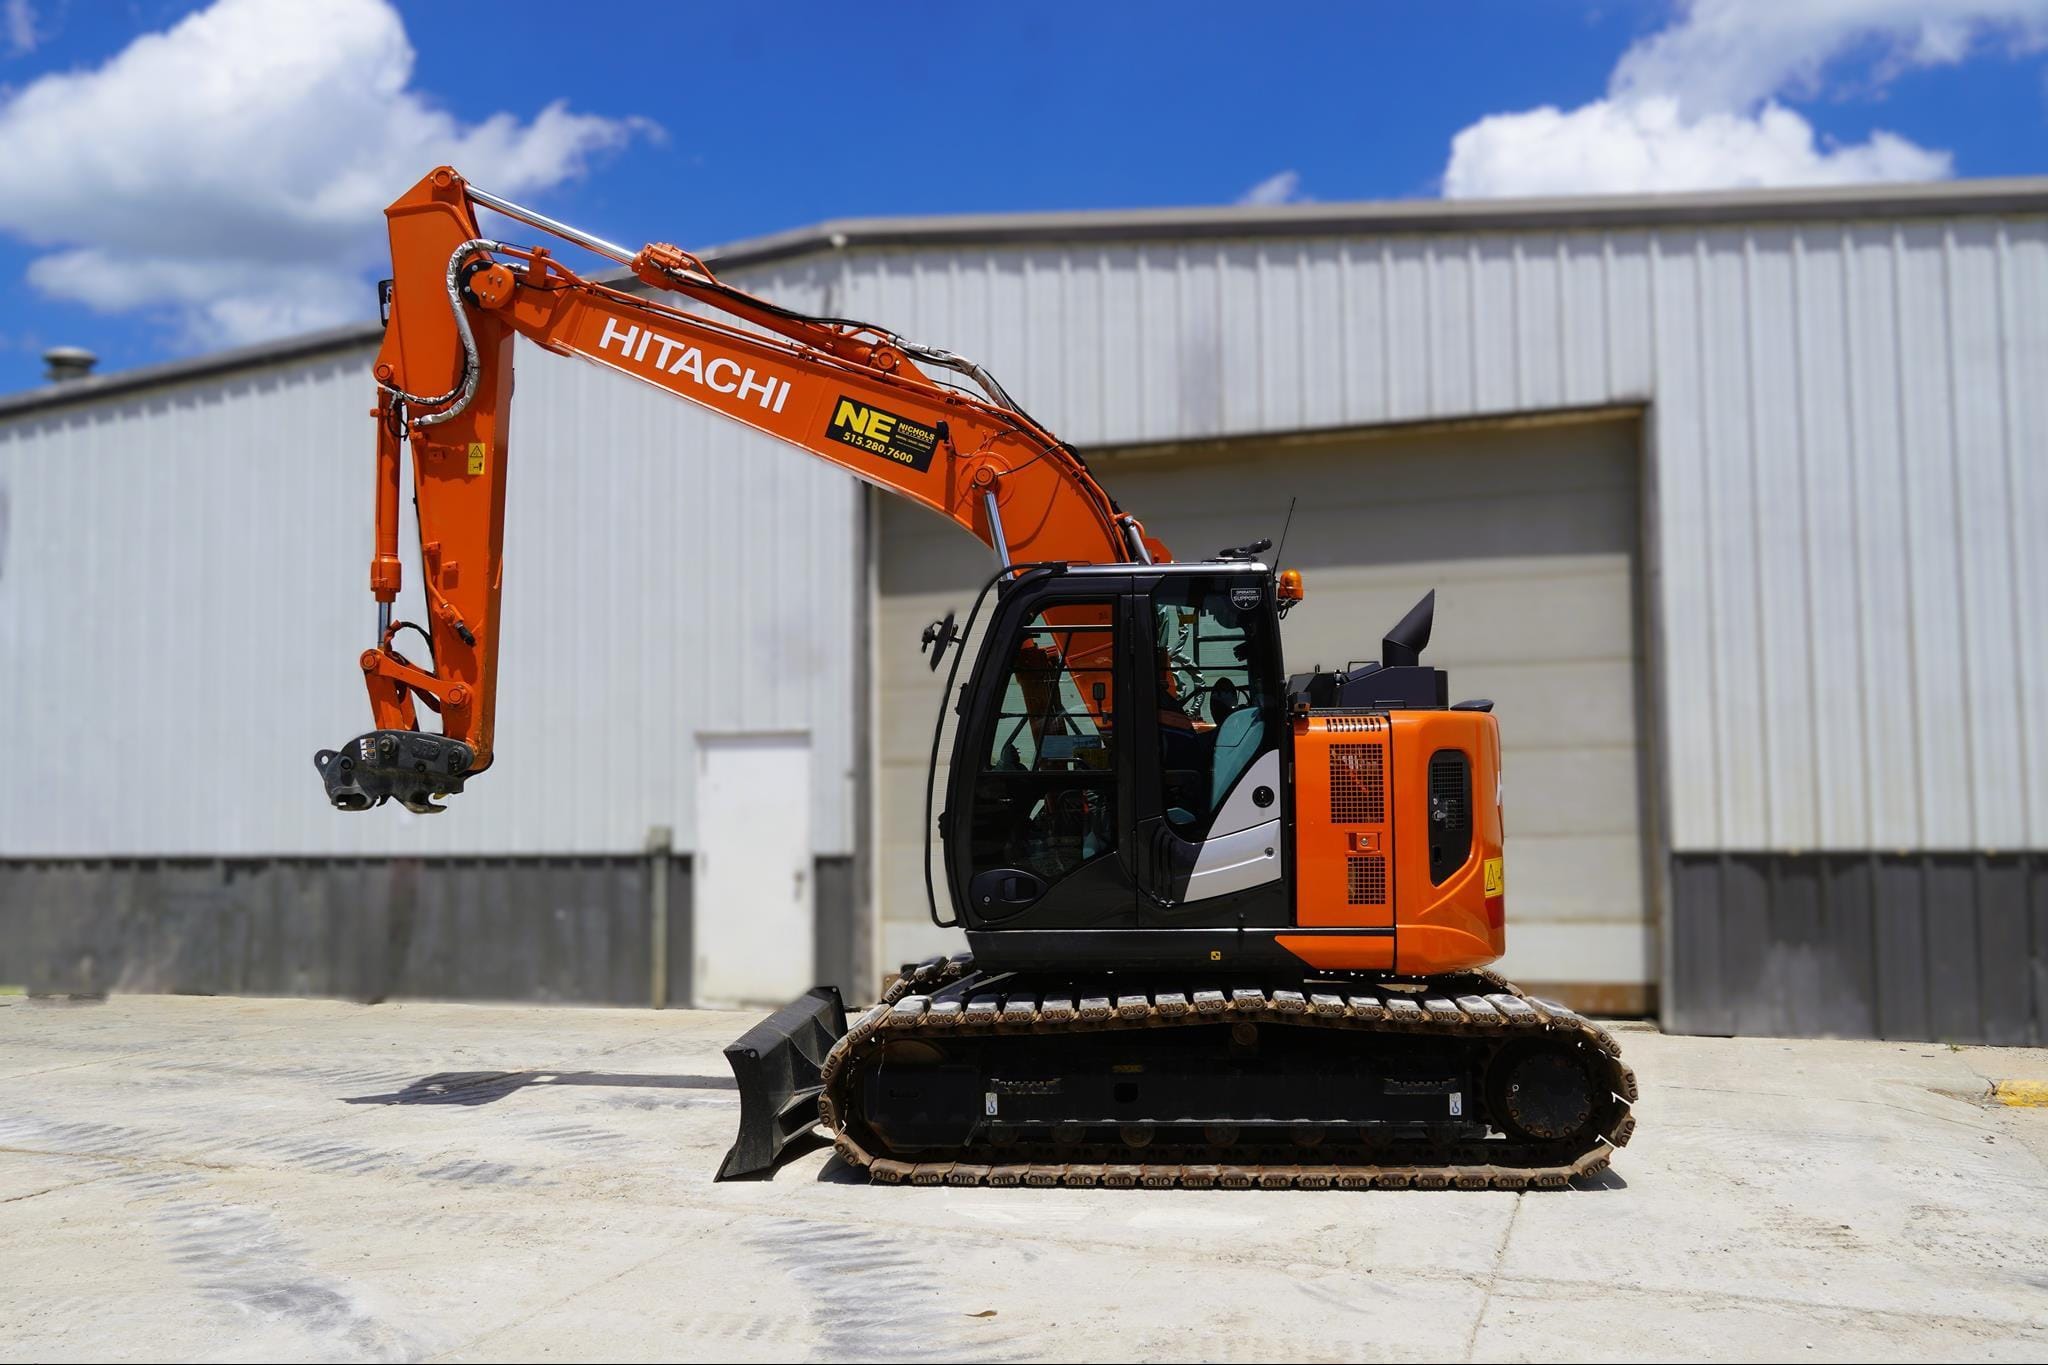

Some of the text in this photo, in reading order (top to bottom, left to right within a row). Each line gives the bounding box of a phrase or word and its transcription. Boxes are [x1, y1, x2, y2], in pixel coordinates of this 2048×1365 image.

[599, 317, 791, 414] HITACHI
[834, 400, 897, 443] NE
[899, 422, 936, 440] NICHOLS
[843, 432, 913, 463] 515.280.7600
